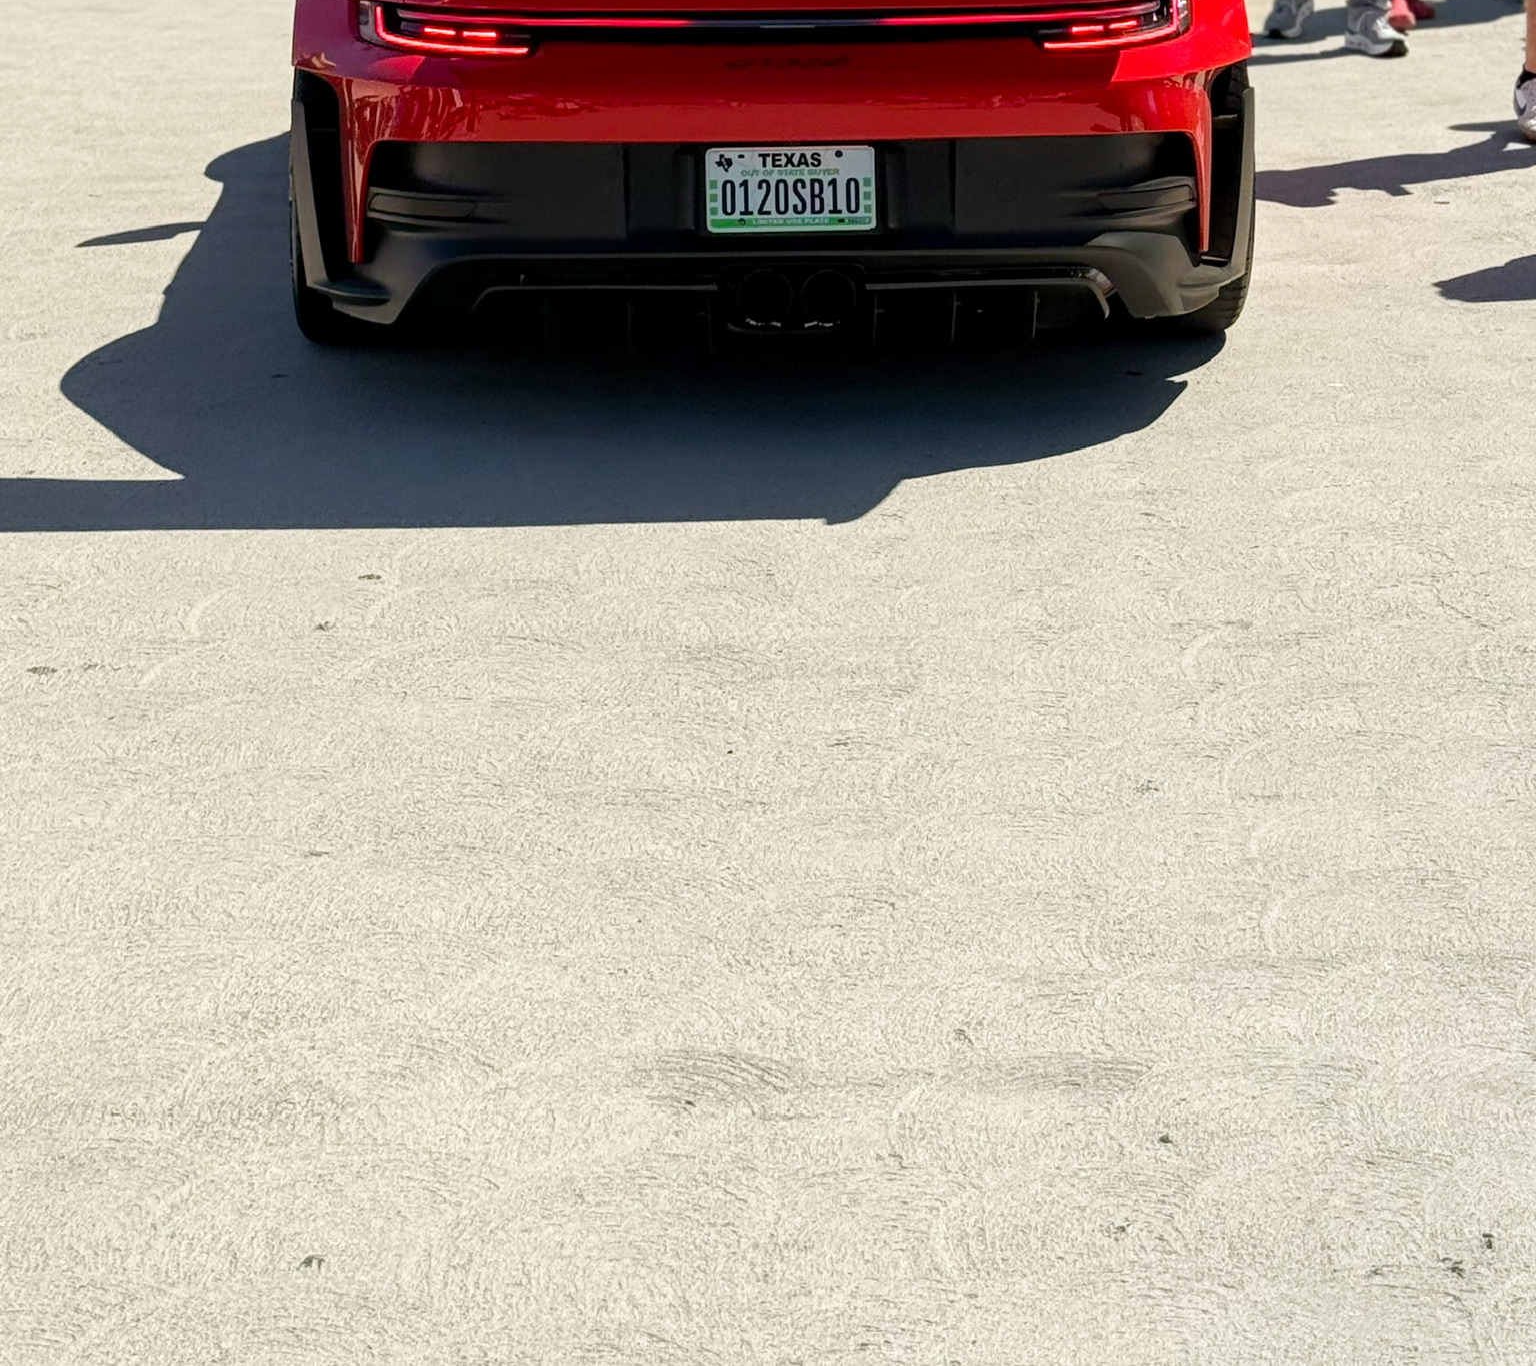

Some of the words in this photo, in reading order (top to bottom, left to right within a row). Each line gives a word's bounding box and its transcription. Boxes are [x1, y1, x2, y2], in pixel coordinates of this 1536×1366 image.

[758, 152, 822, 168] TEXAS
[741, 169, 760, 177] OUT
[762, 169, 775, 177] OF
[777, 169, 806, 177] STATE
[807, 168, 840, 176] BUYER
[721, 177, 861, 216] 0120SB10
